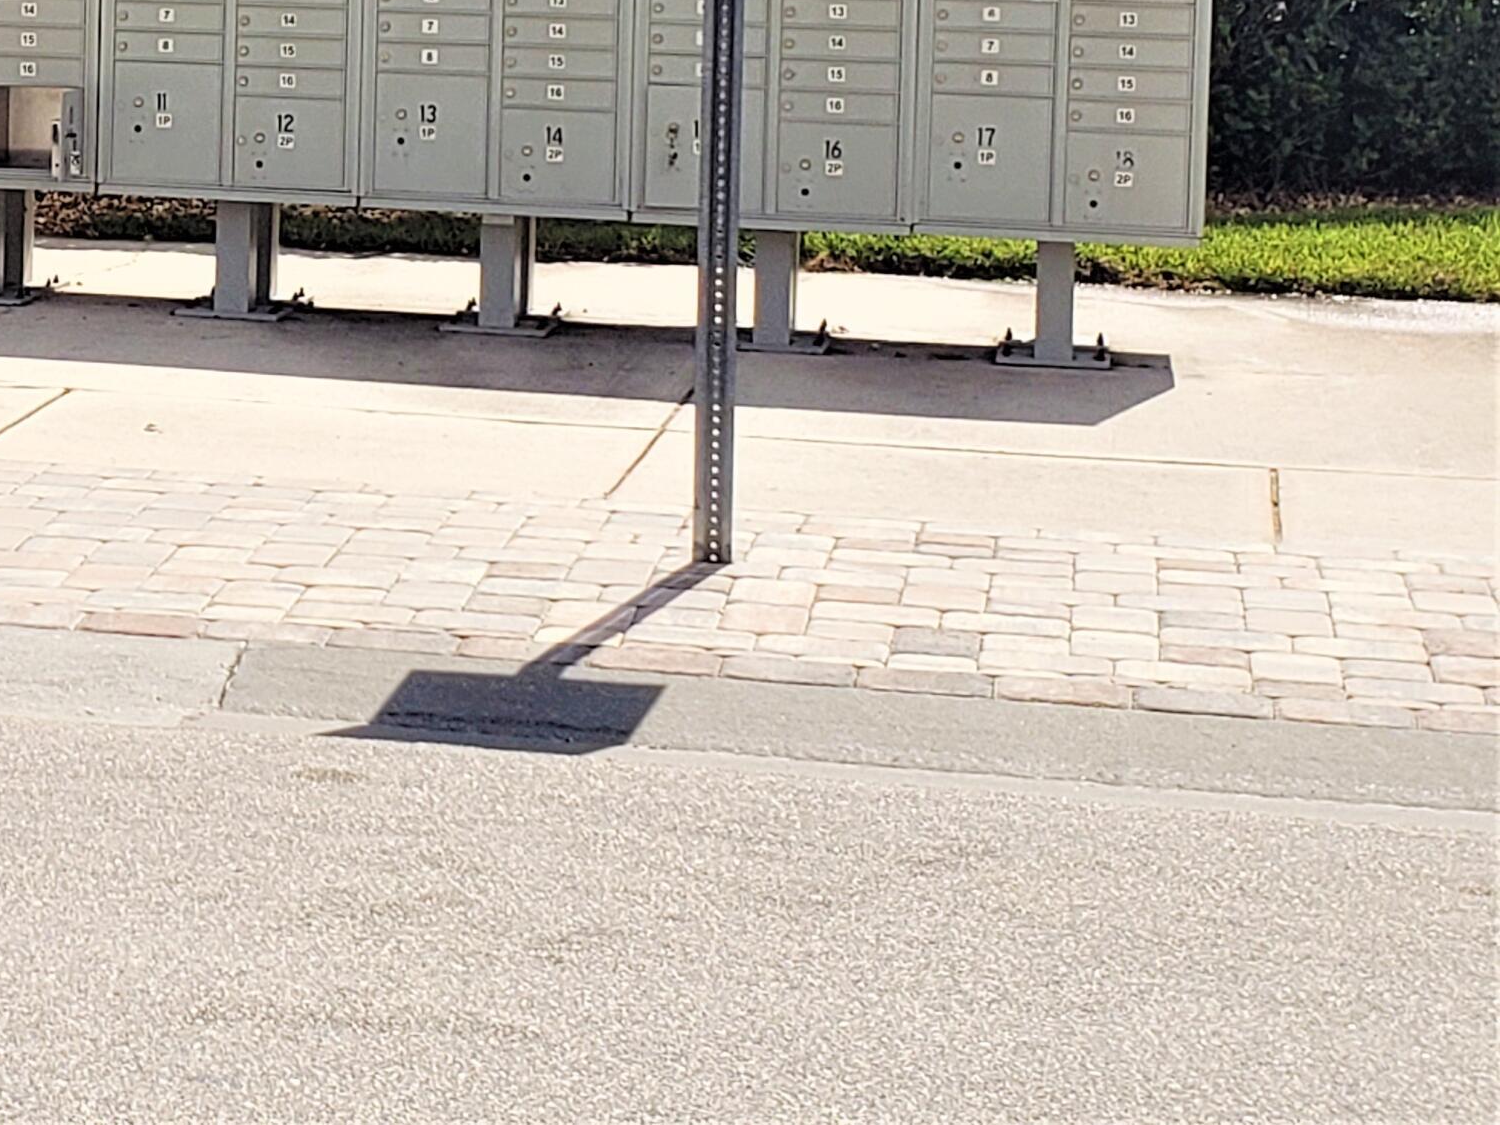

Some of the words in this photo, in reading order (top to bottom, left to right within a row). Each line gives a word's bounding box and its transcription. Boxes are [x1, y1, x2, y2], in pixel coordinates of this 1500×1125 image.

[24, 4, 35, 14] 14
[832, 6, 844, 17] 13
[284, 15, 295, 25] 14
[1122, 14, 1135, 25] 13
[552, 26, 564, 36] 14
[23, 34, 35, 45] 15
[831, 37, 843, 47] 14
[283, 45, 295, 56] 15
[1121, 46, 1134, 56] 14
[551, 56, 564, 67] 15
[830, 69, 843, 80] 15
[1120, 79, 1134, 89] 15
[550, 87, 562, 97] 16
[157, 92, 167, 111] 11
[829, 100, 842, 111] 16
[420, 104, 437, 124] 13
[158, 115, 171, 125] 1P
[277, 113, 294, 133] 12
[421, 127, 436, 138] 1P
[546, 126, 563, 146] 14
[978, 127, 996, 147] 17
[279, 136, 294, 147] 2P
[548, 149, 564, 160] 2P
[825, 140, 842, 160] 16
[980, 152, 994, 162] 1P
[827, 163, 843, 174] 2P
[1116, 174, 1132, 185] 2P
